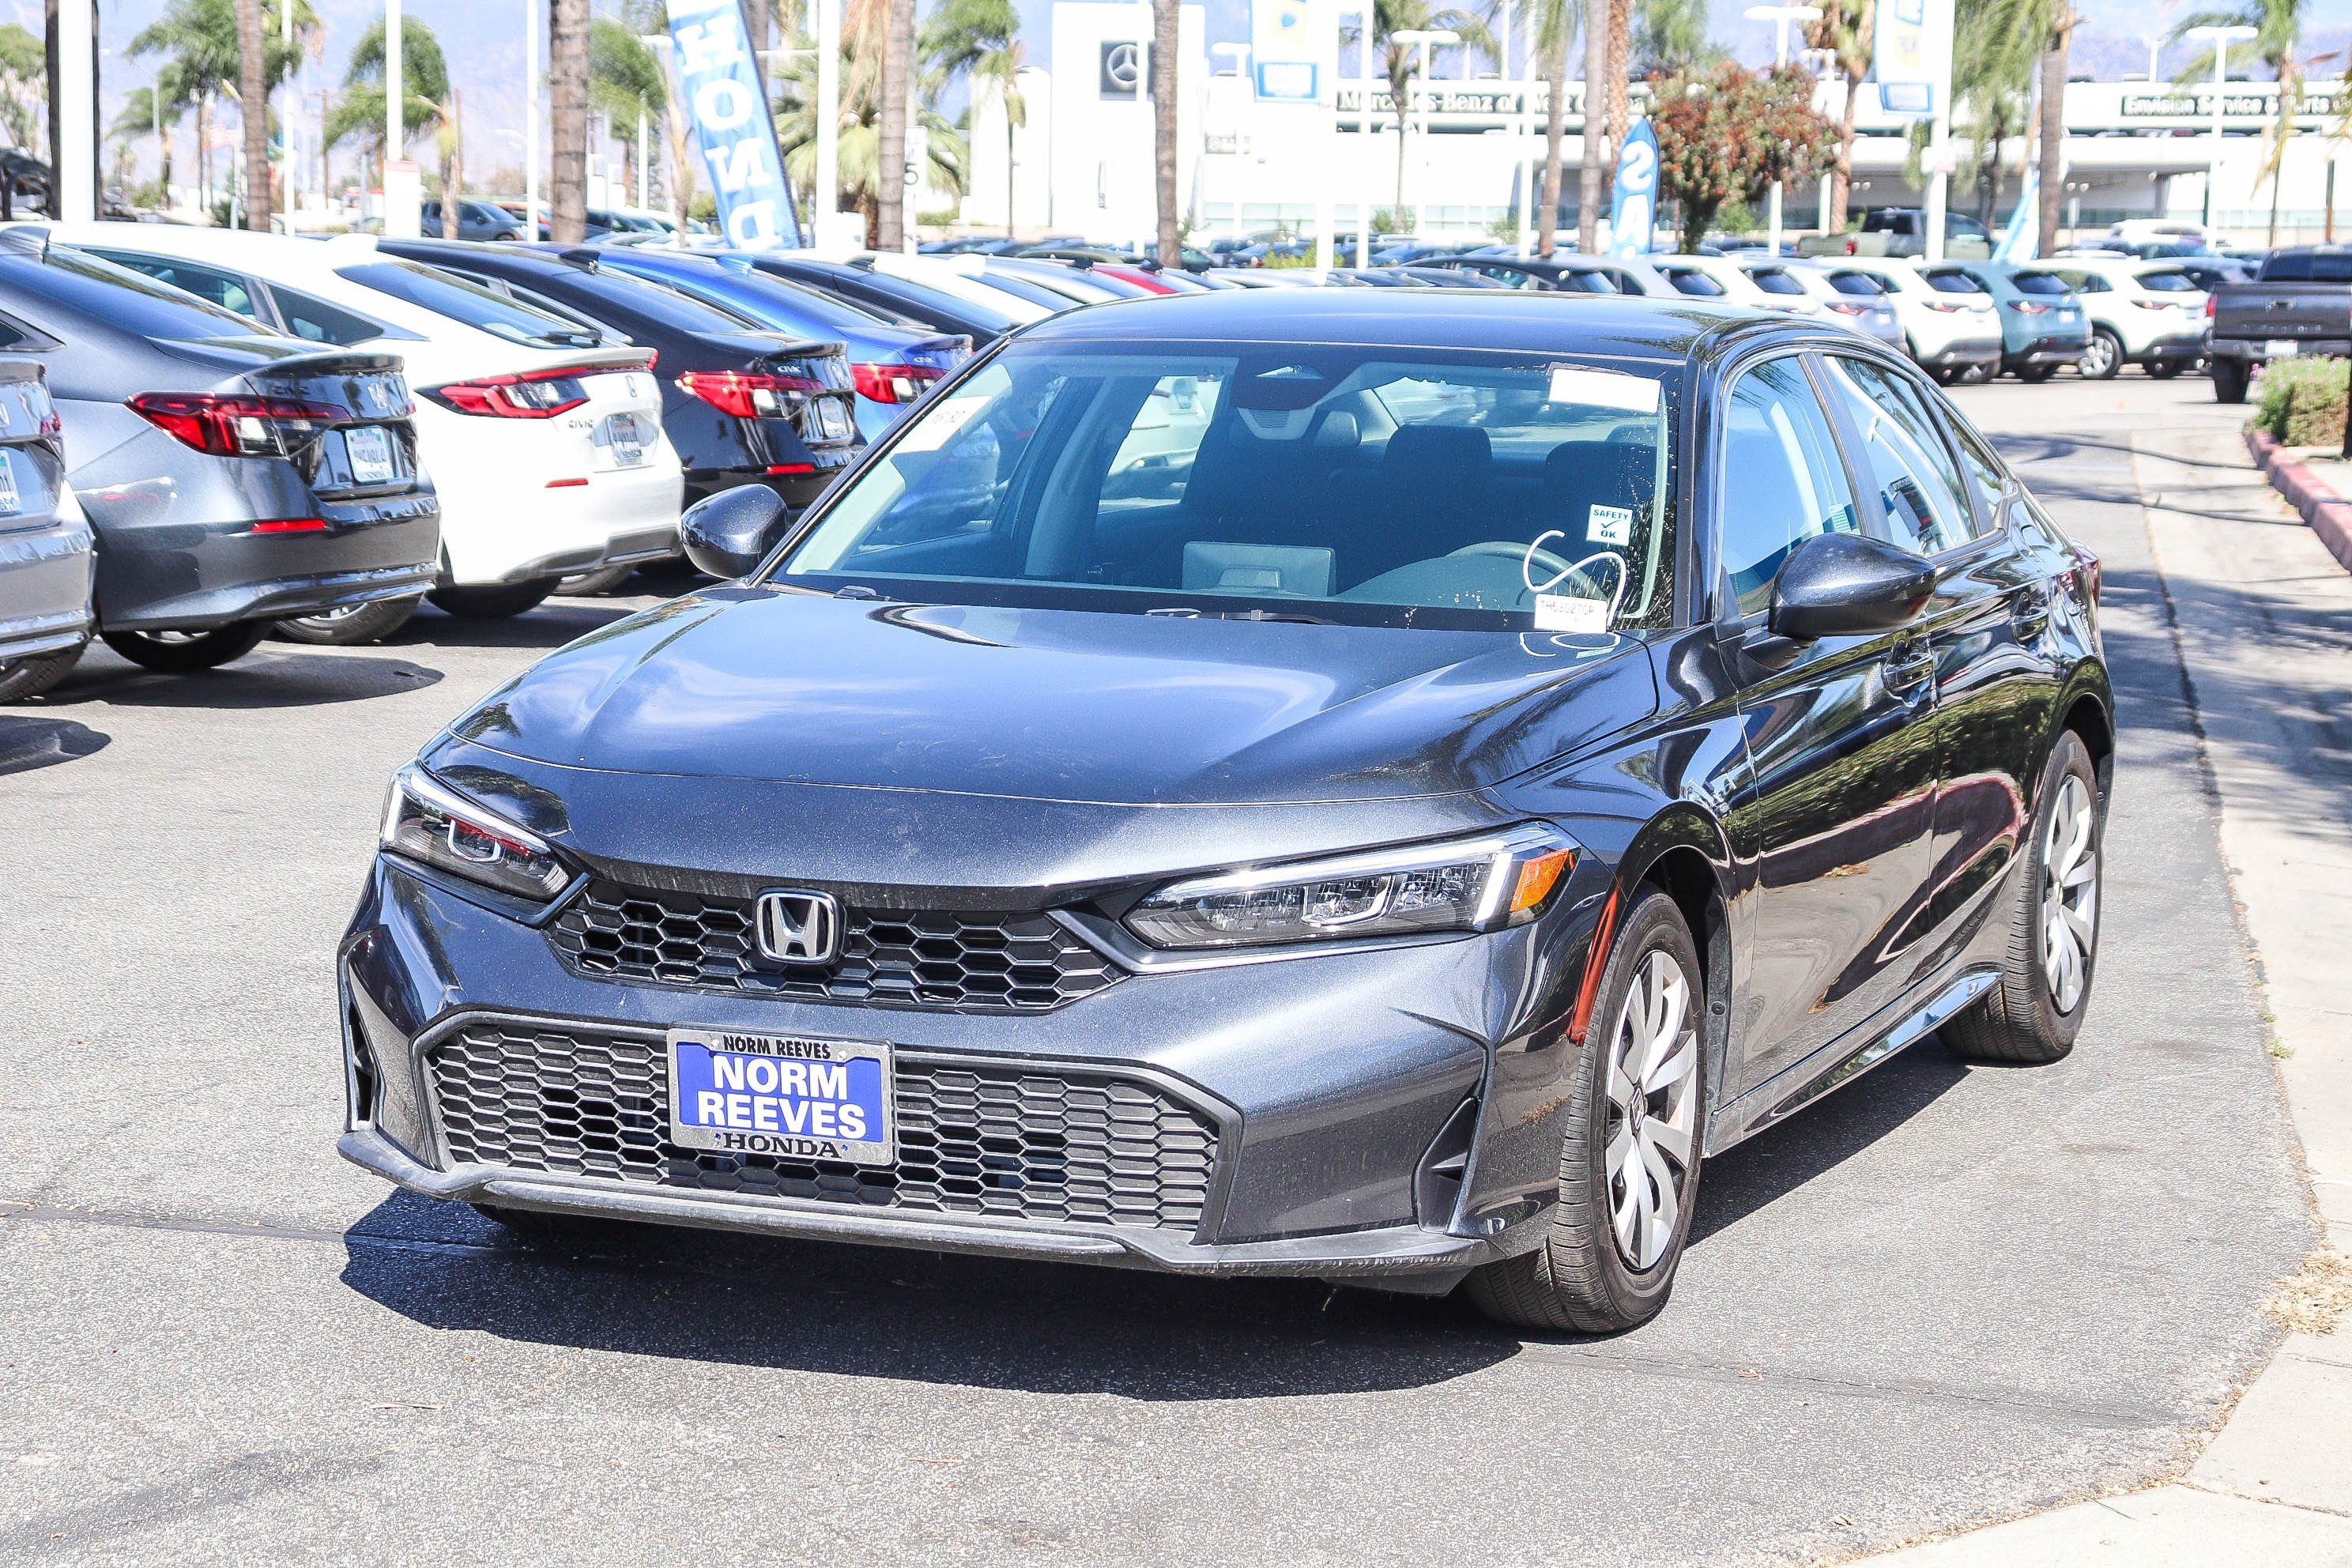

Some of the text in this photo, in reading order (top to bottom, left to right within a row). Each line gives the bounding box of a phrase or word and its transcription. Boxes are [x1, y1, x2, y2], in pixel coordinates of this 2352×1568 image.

[1338, 89, 1494, 113] Mrcds-Benz
[1494, 89, 1520, 113] of
[2197, 94, 2263, 115] Srvice
[1593, 508, 1629, 520] SAFETY
[1600, 530, 1616, 538] OK
[722, 1035, 831, 1060] NORM REEVES
[712, 1054, 848, 1102] NORM
[697, 1090, 867, 1140] REEVES
[722, 1132, 842, 1159] HONDA
